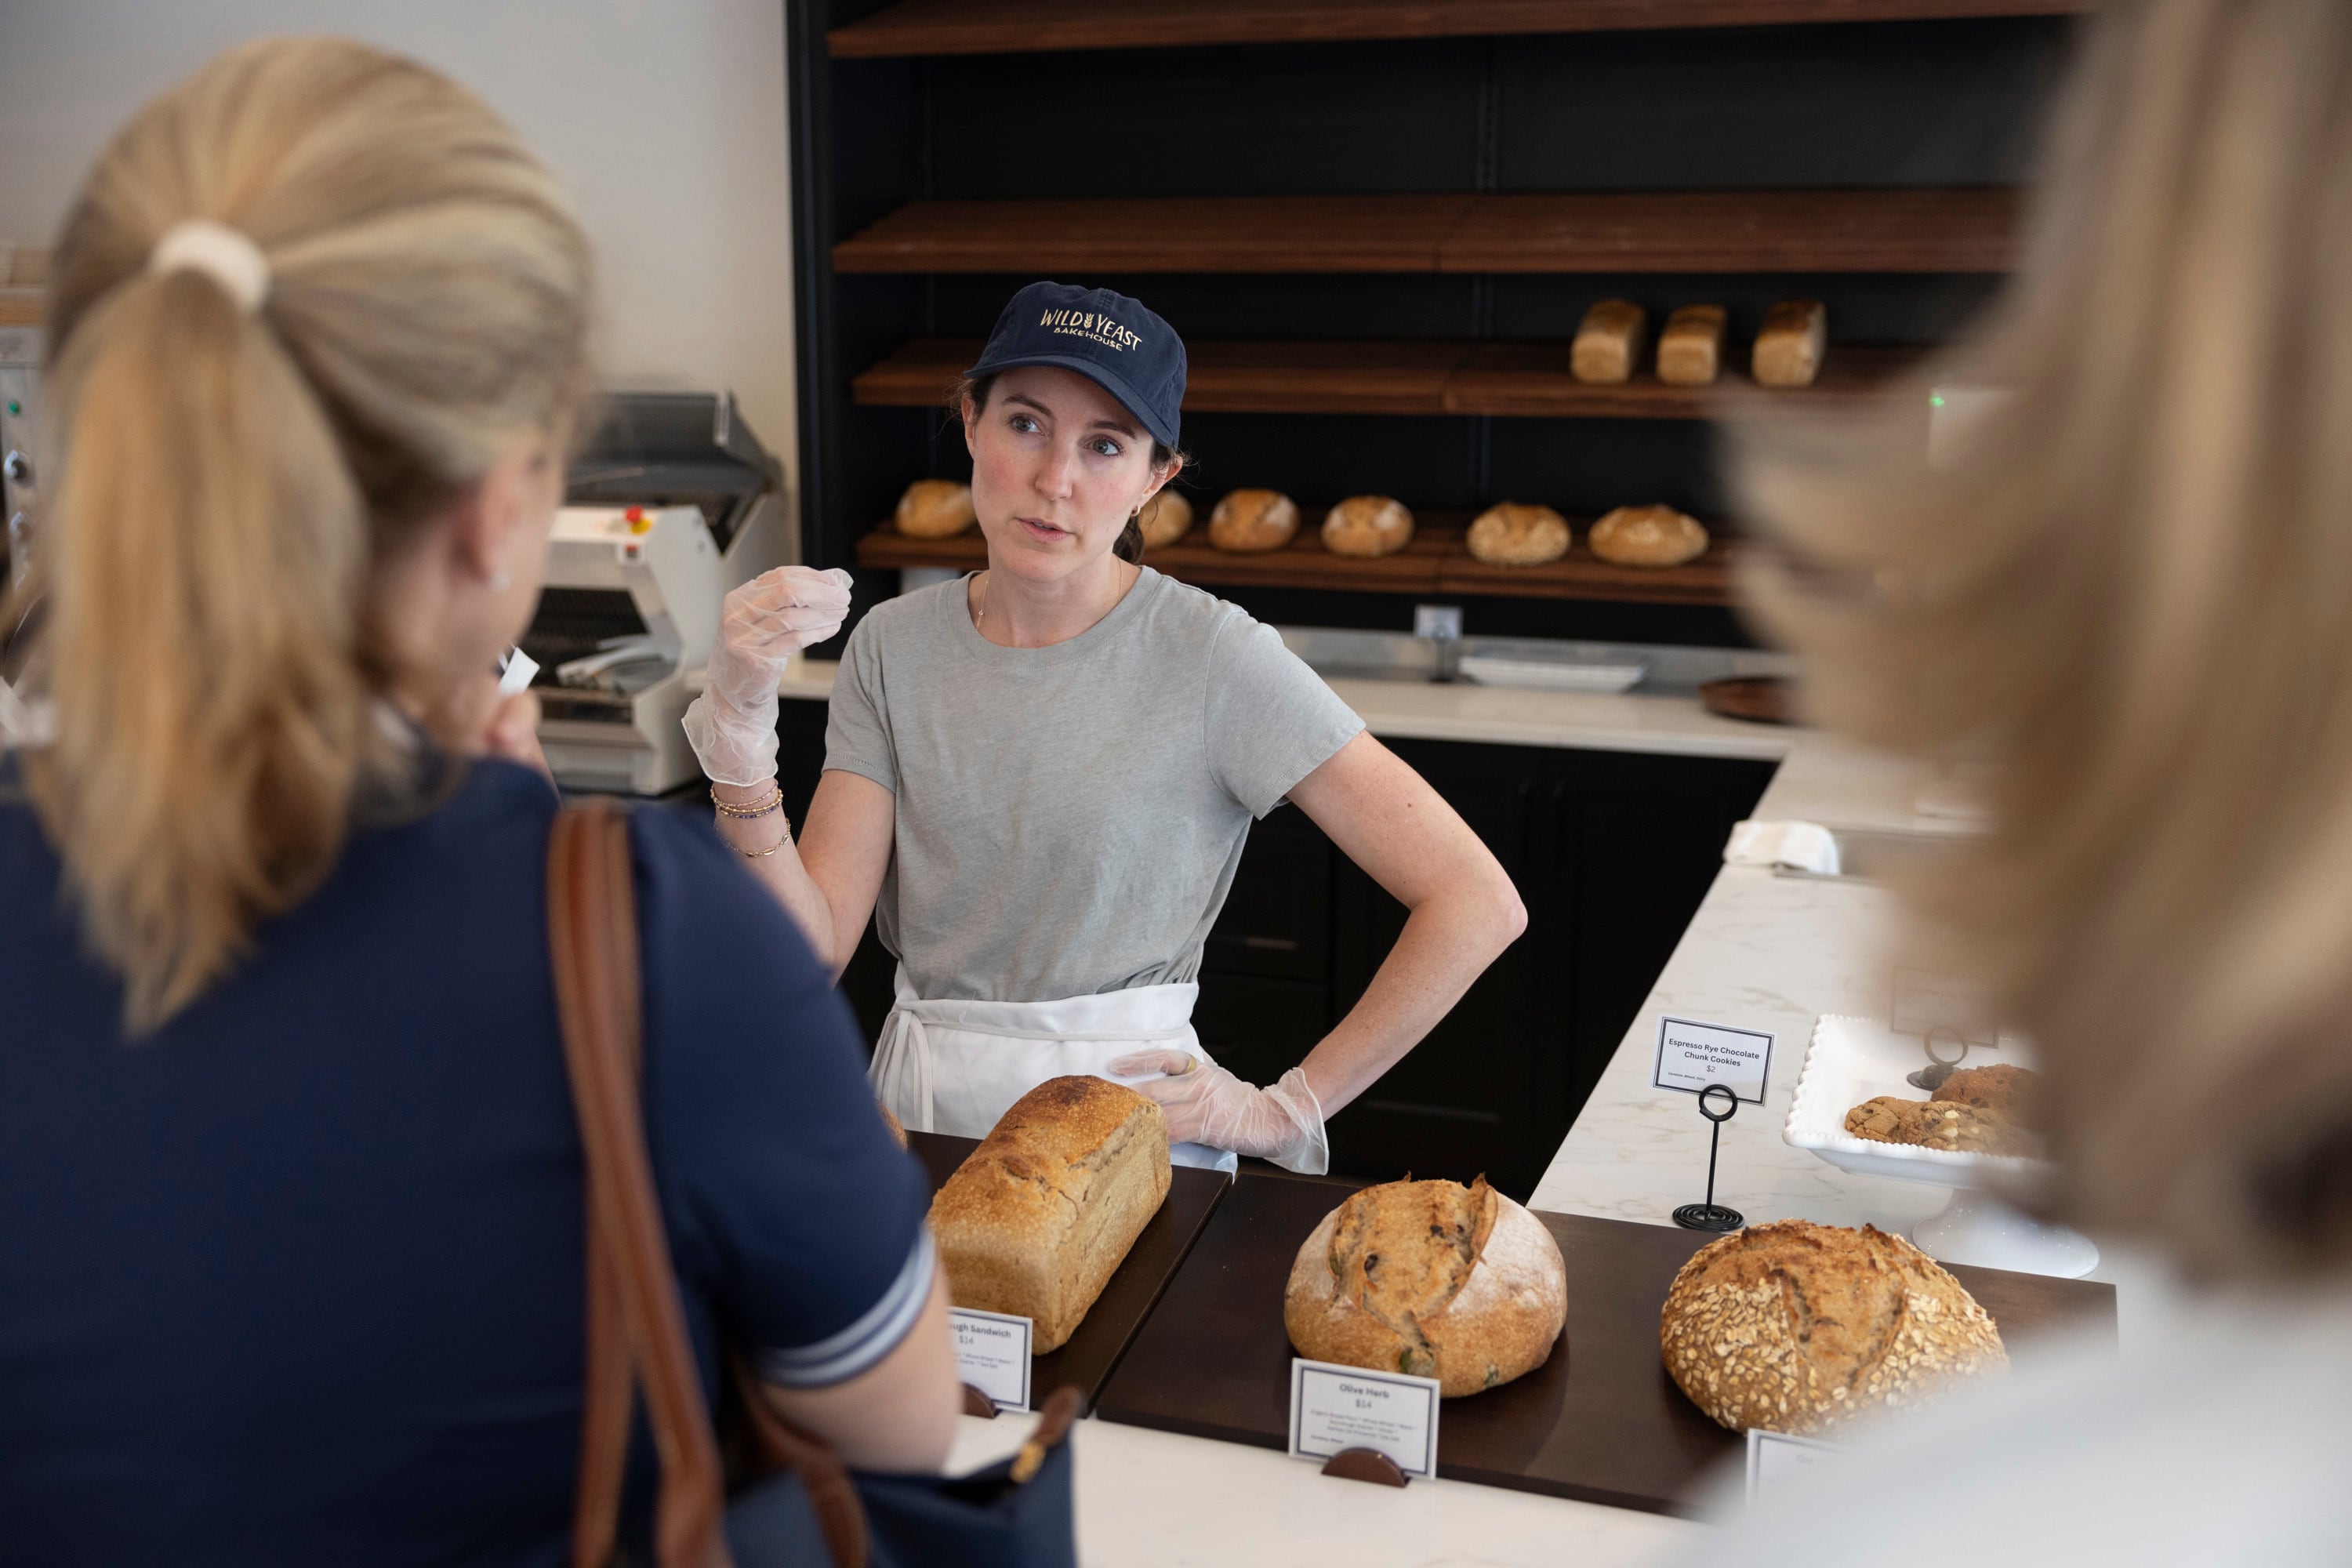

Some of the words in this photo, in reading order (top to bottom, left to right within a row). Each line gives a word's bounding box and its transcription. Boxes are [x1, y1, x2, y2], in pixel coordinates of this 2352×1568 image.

[1040, 308, 1083, 327] WILD
[1095, 313, 1143, 351] YEAST
[1053, 327, 1123, 352] BAKEHOUSE
[1668, 1038, 1703, 1050] Espresso
[1704, 1044, 1719, 1053] Rye
[1720, 1047, 1760, 1059] Chocolate
[1684, 1051, 1709, 1062] Chunk
[1710, 1055, 1741, 1066] Cookies
[1706, 1065, 1716, 1073] $2
[971, 1324, 1011, 1338] Sandwich
[959, 1335, 974, 1345] $14
[1339, 1384, 1364, 1395] Olive
[1366, 1388, 1390, 1399] Herb
[1355, 1399, 1372, 1410] $14
